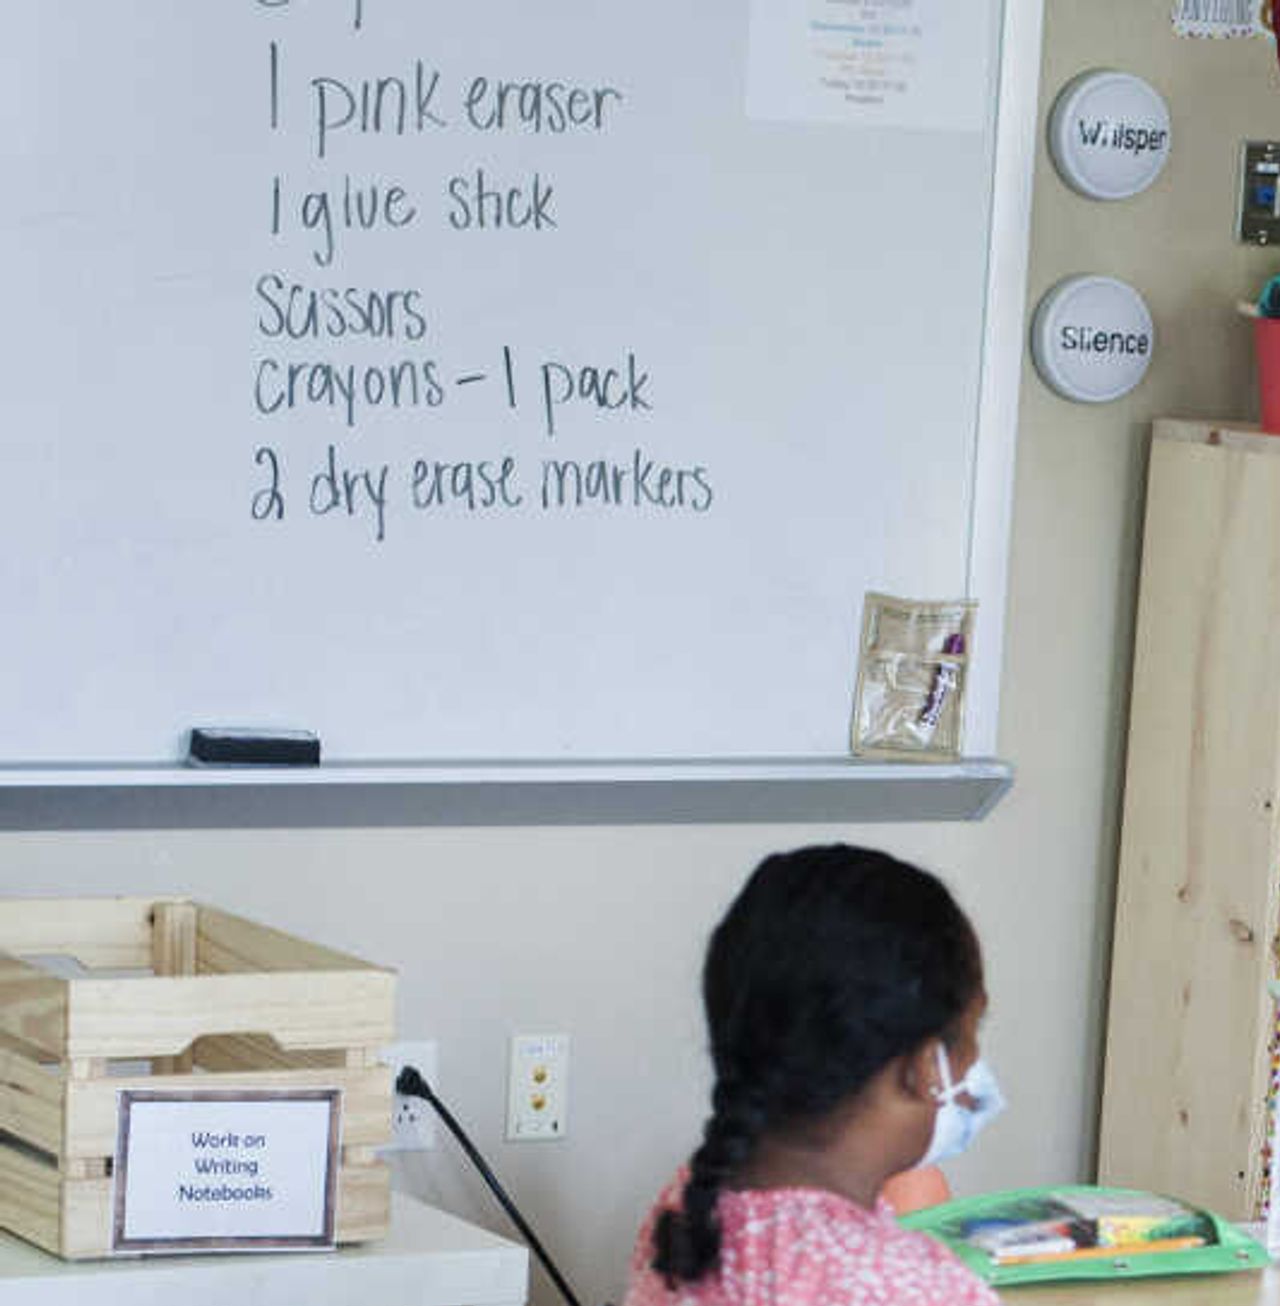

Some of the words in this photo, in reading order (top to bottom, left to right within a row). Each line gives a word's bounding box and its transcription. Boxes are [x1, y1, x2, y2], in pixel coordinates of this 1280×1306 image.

[311, 58, 447, 158] pink
[463, 75, 623, 134] eraser
[302, 174, 417, 267] glue
[447, 168, 558, 231] stick
[1061, 325, 1150, 356] Silence
[254, 357, 444, 427] crayons
[542, 352, 653, 437] pack
[251, 446, 284, 520] 2
[309, 444, 389, 542] dry
[411, 456, 524, 511] erase
[541, 448, 713, 513] markers
[191, 1132, 240, 1149] Work
[243, 1134, 266, 1149] on
[194, 1157, 259, 1178] Writing
[180, 1184, 272, 1201] Notebooks
